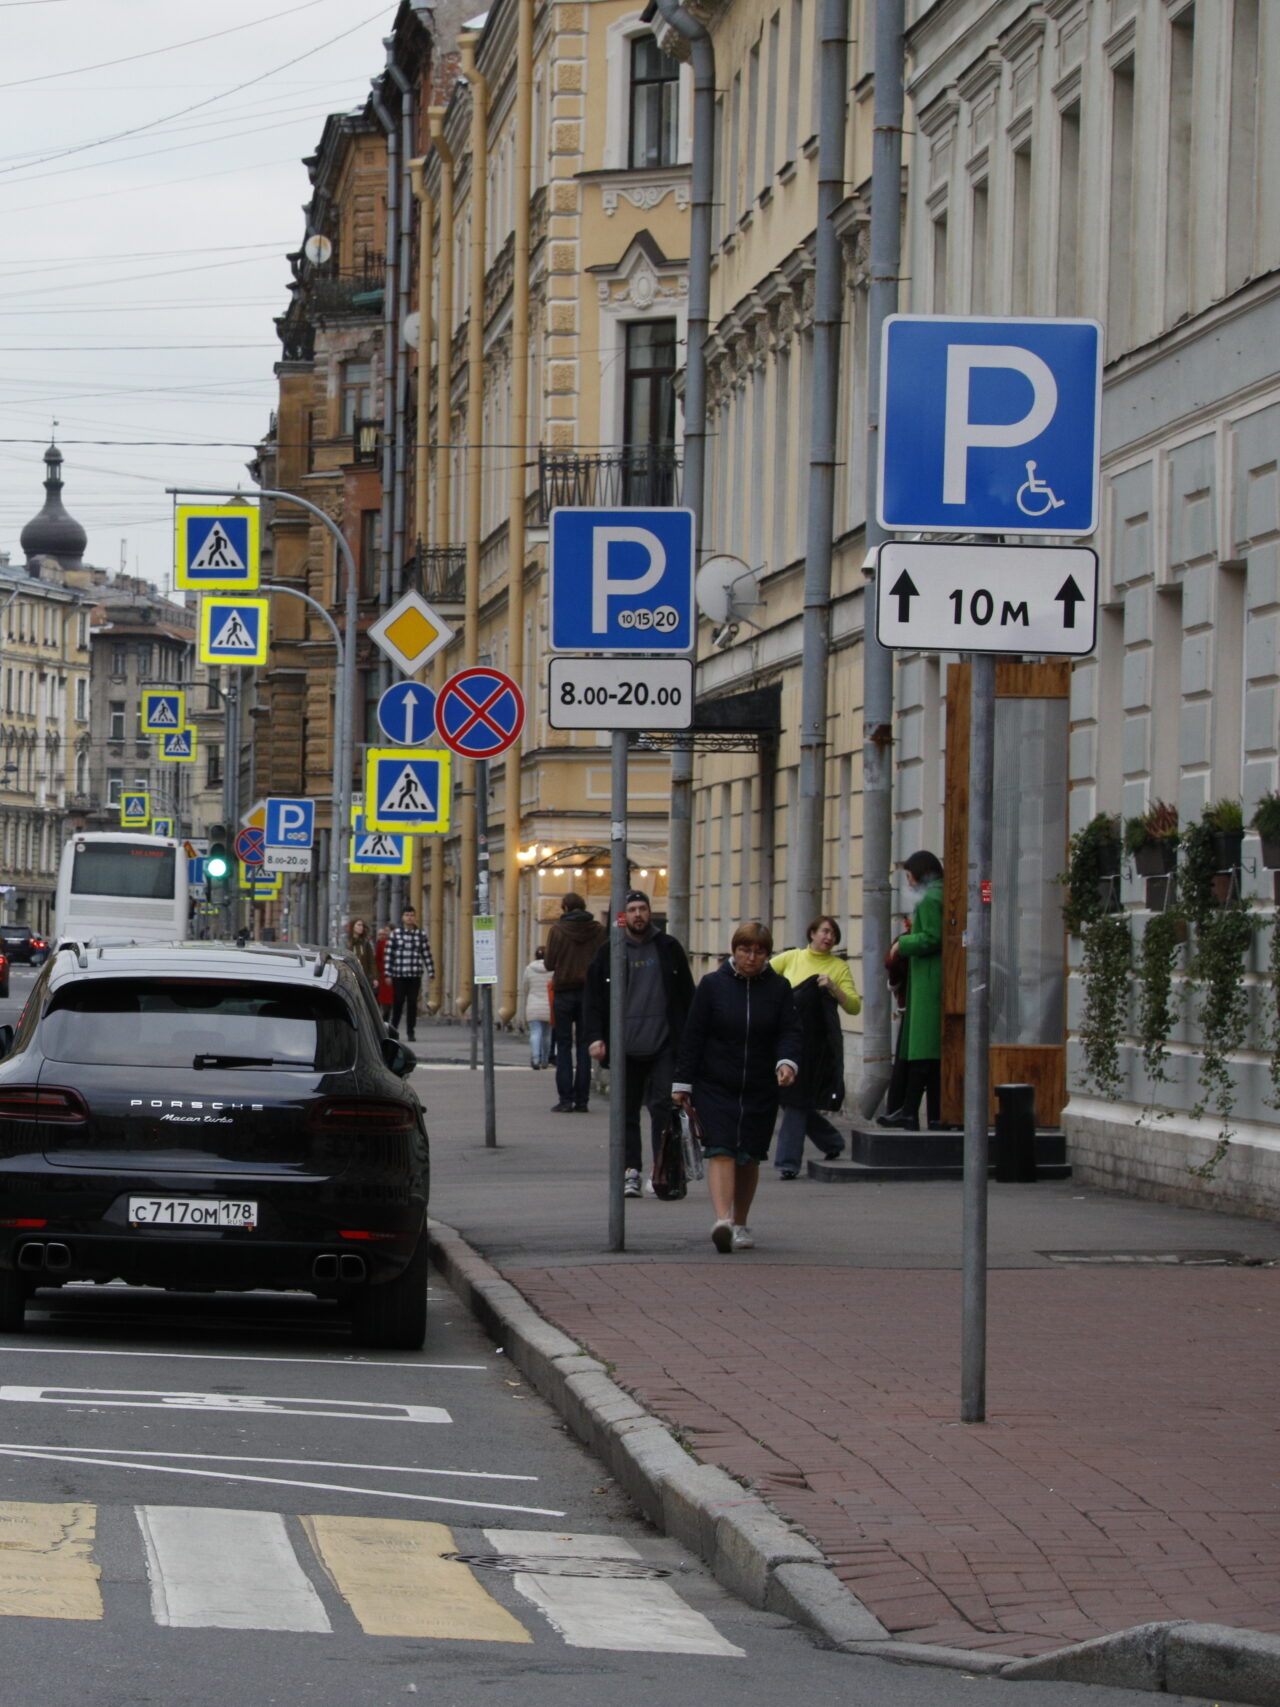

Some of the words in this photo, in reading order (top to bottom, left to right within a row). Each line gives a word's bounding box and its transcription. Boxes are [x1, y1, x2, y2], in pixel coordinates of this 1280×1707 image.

[942, 344, 1059, 505] P
[591, 526, 668, 634] P
[621, 614, 634, 625] 10
[637, 612, 651, 626] 15
[655, 611, 678, 628] 20
[560, 682, 682, 706] 8.00-20.00
[278, 804, 305, 841] P
[130, 1099, 264, 1111] PORSCHE
[160, 1113, 201, 1123] Macan
